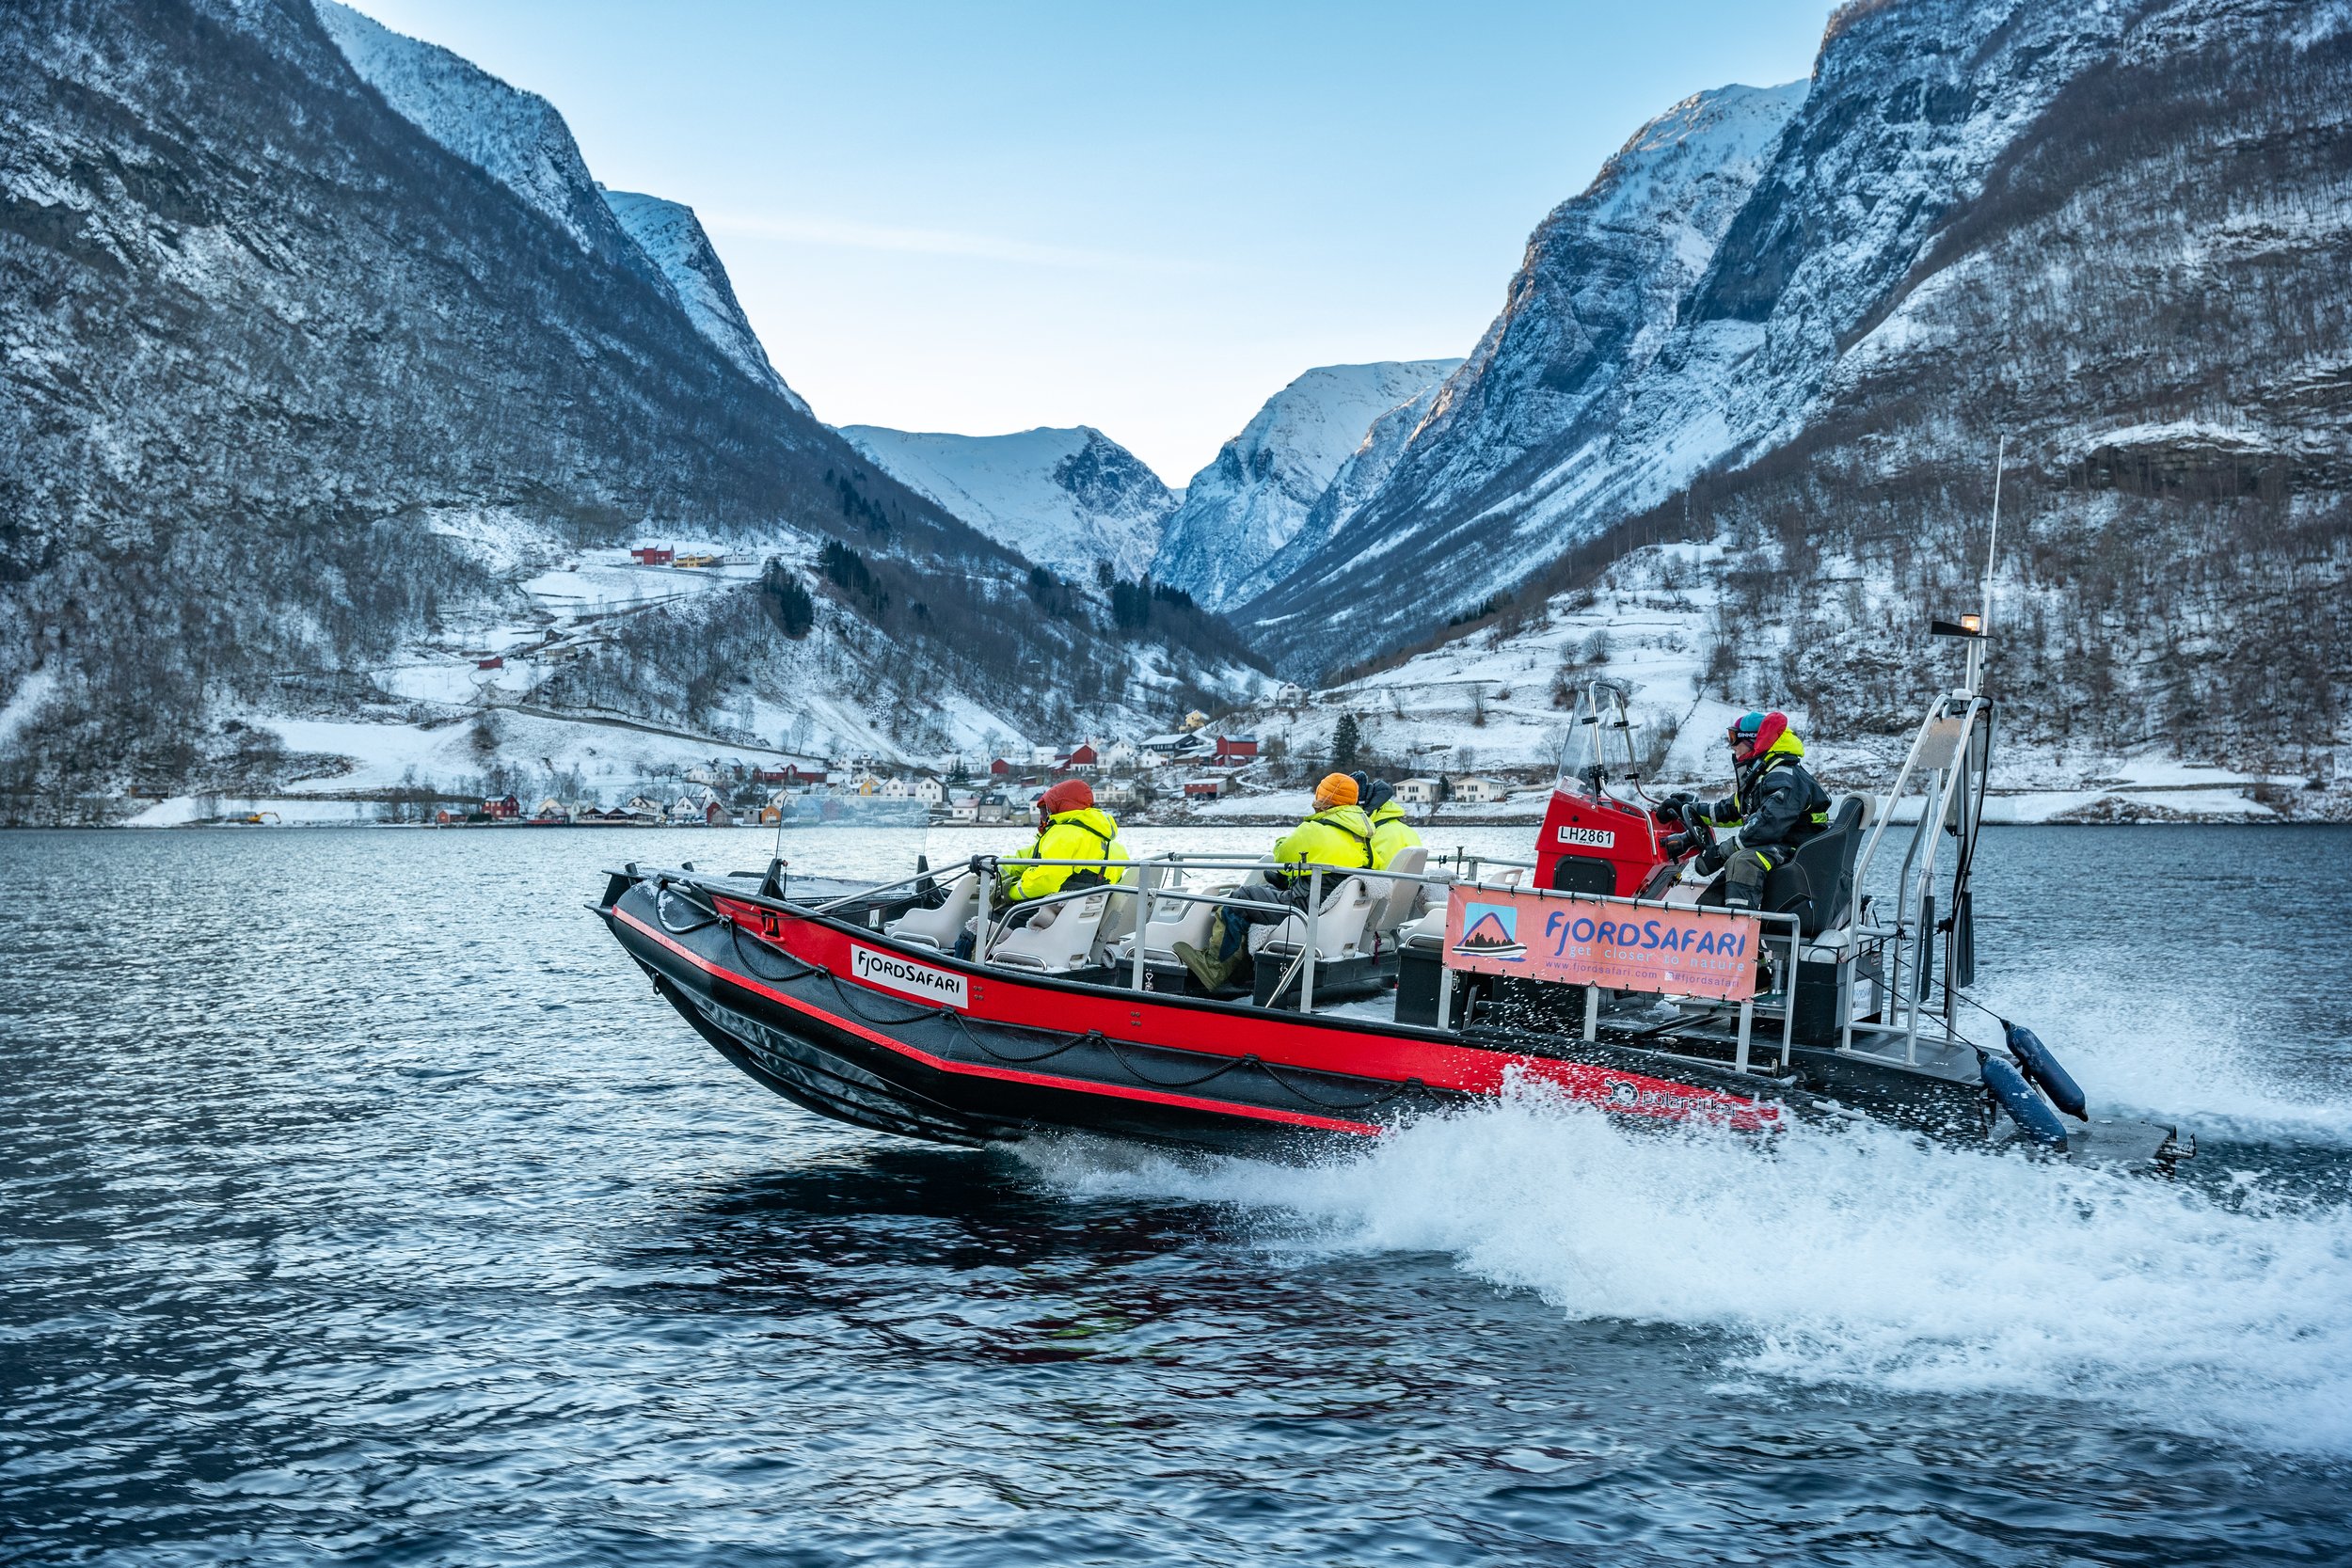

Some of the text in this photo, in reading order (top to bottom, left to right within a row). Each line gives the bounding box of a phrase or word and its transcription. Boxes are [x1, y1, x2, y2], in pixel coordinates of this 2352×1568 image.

[1560, 827, 1611, 845] LH2861
[1569, 944, 1745, 973] get closer to nature
[1545, 959, 1740, 989] www.fjordsafari.com #fjordsafari
[1642, 1090, 1737, 1117] polarcirkel
